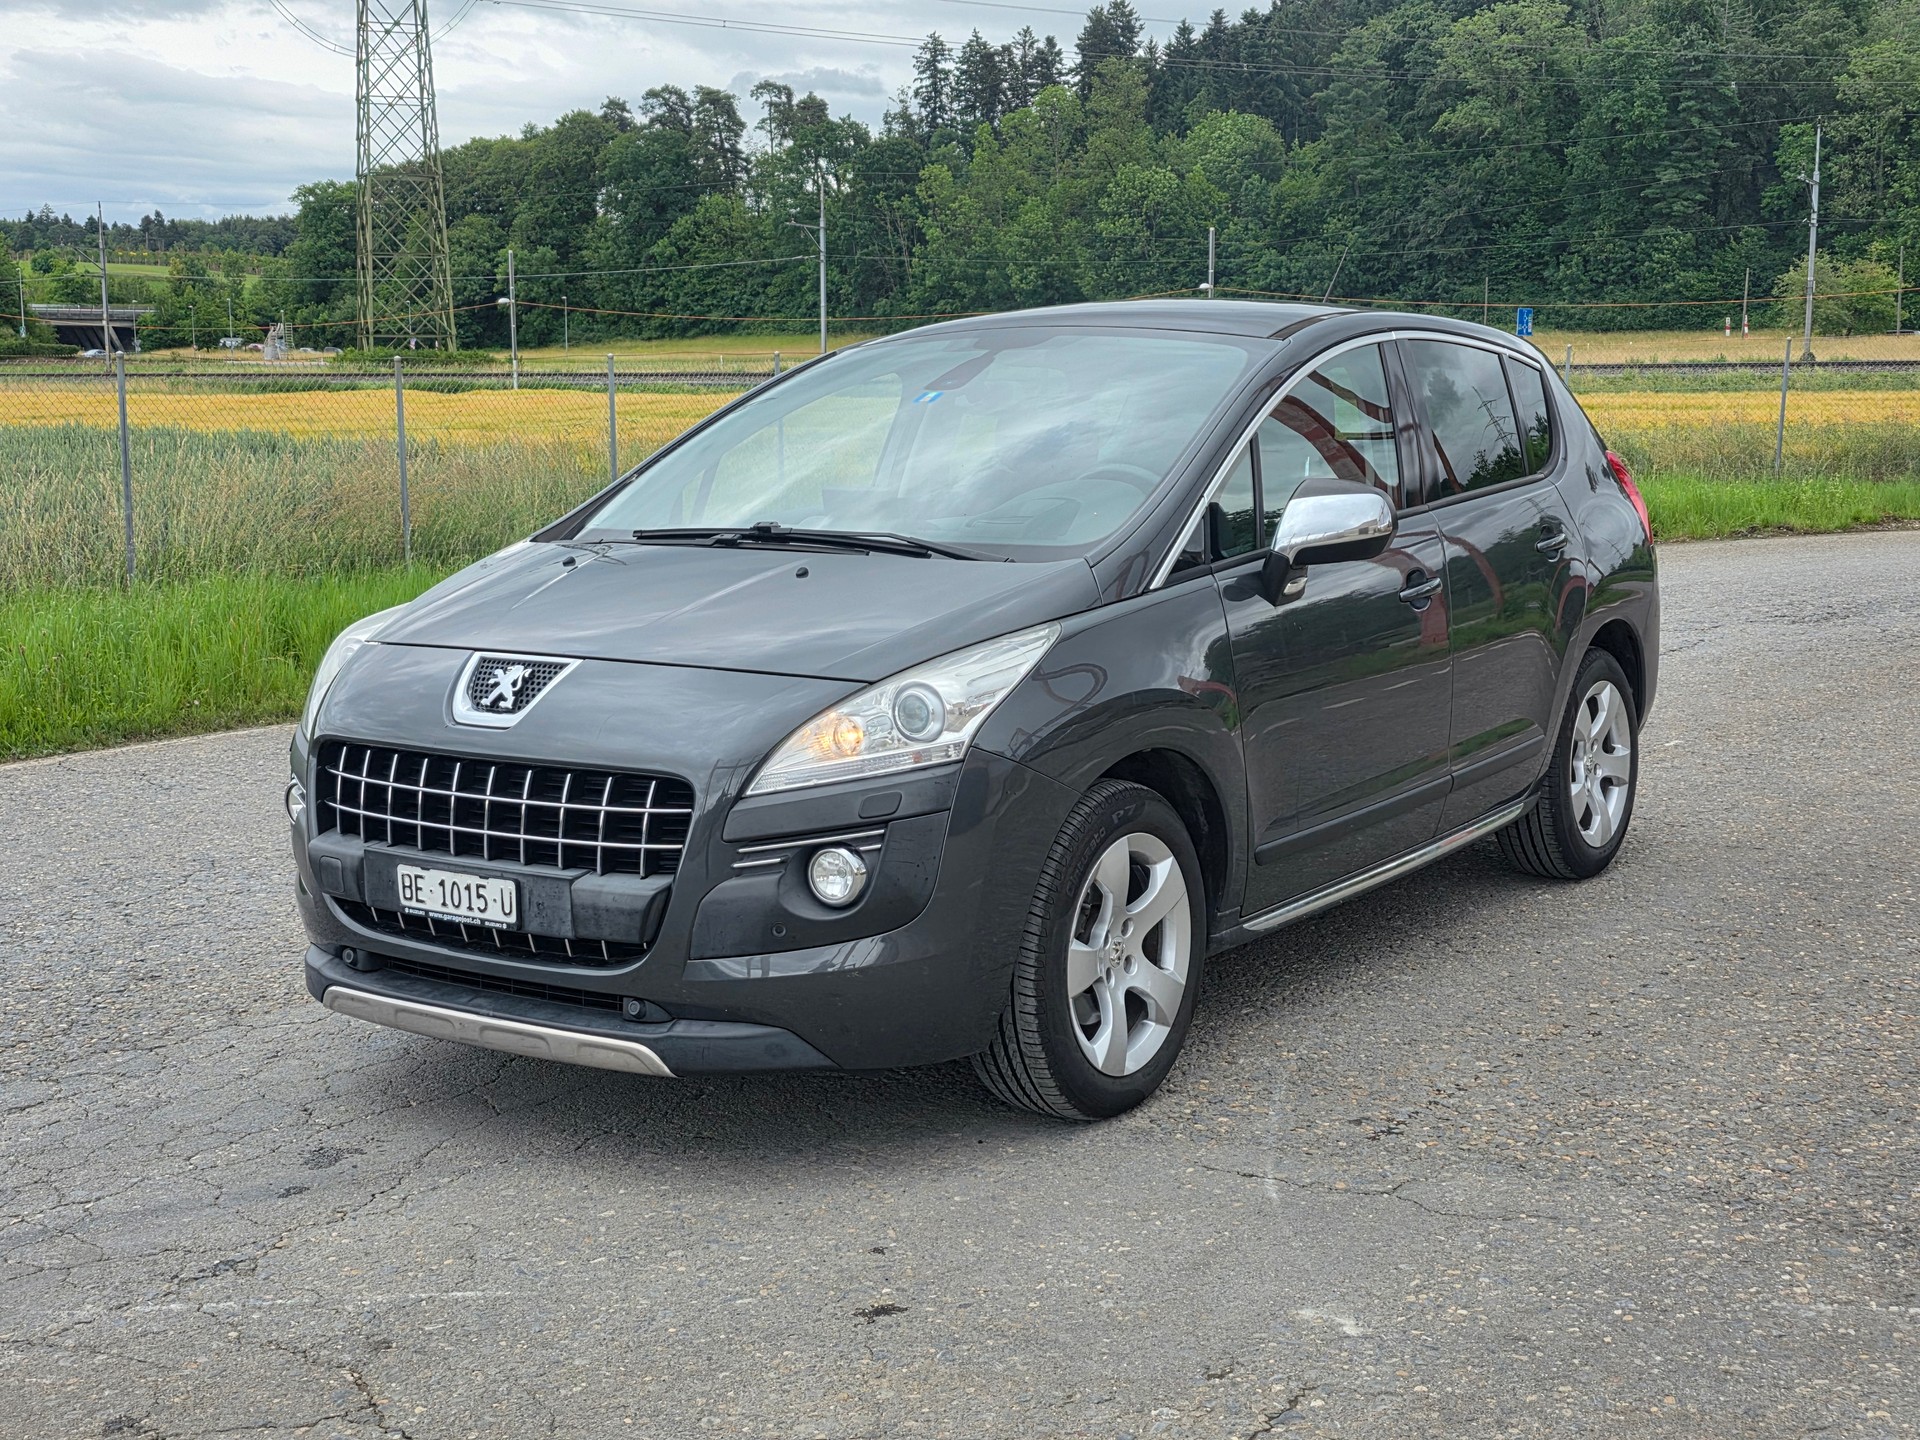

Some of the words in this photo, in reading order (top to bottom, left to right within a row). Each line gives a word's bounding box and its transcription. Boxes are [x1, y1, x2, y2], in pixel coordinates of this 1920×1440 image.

[1112, 803, 1136, 824] P7
[401, 873, 426, 904] BE
[438, 878, 488, 913] 1015
[500, 886, 512, 917] U
